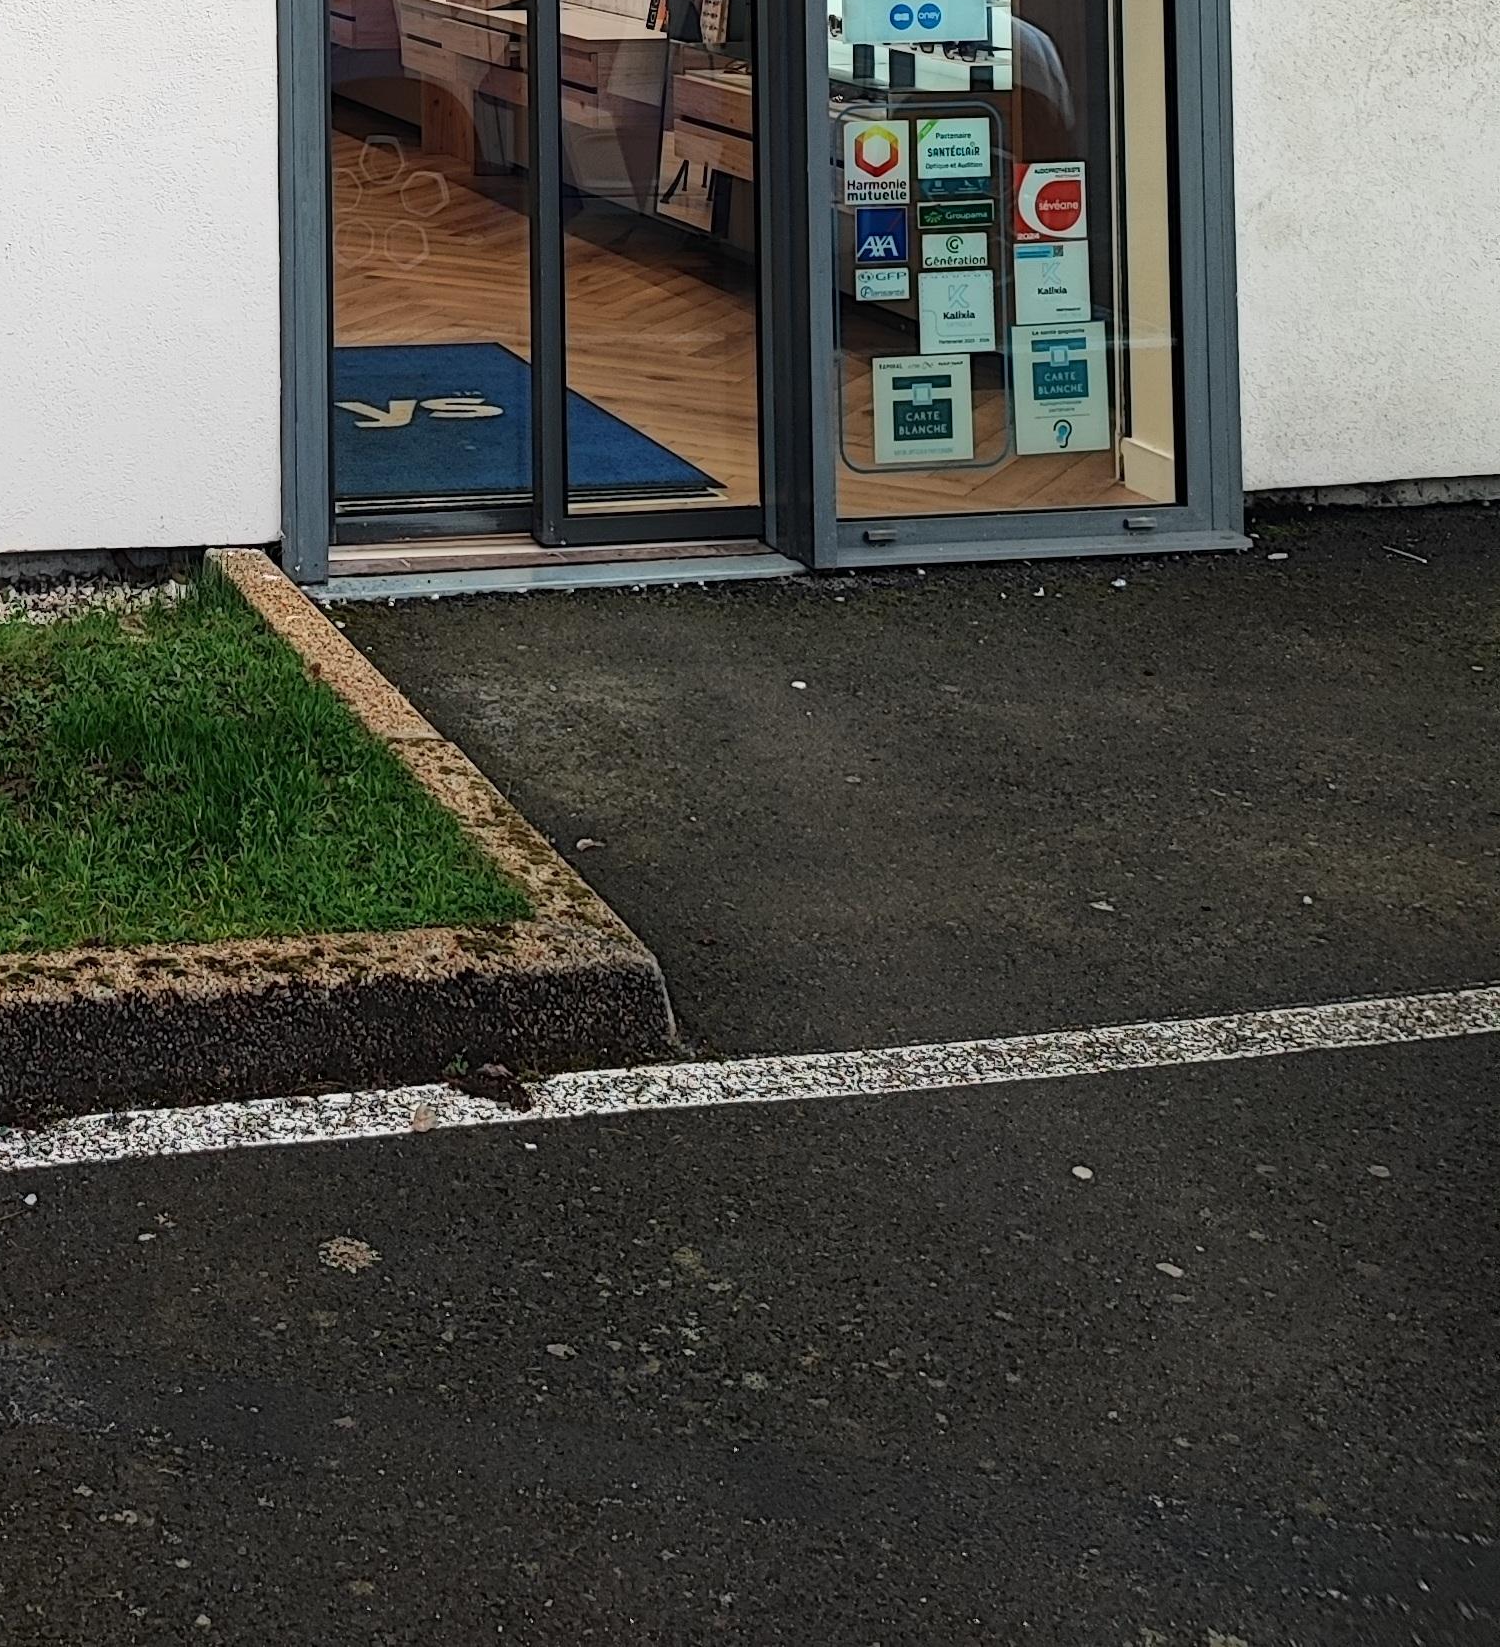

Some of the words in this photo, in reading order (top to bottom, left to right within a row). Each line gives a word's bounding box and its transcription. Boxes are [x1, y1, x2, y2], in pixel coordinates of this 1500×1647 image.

[935, 132, 971, 140] Partenaire
[847, 178, 907, 191] Harmonie
[847, 189, 907, 201] mutuelle
[945, 211, 988, 220] Groupama
[857, 235, 899, 258] AXA
[924, 254, 986, 267] Génération
[875, 271, 907, 281] GFP
[1037, 287, 1068, 296] Kalixia
[943, 310, 976, 320] Kalixia
[1044, 372, 1076, 382] CARTE
[1038, 383, 1084, 395] BLANCHE
[905, 410, 940, 422] CARTE
[898, 423, 948, 436] BLANCHE
